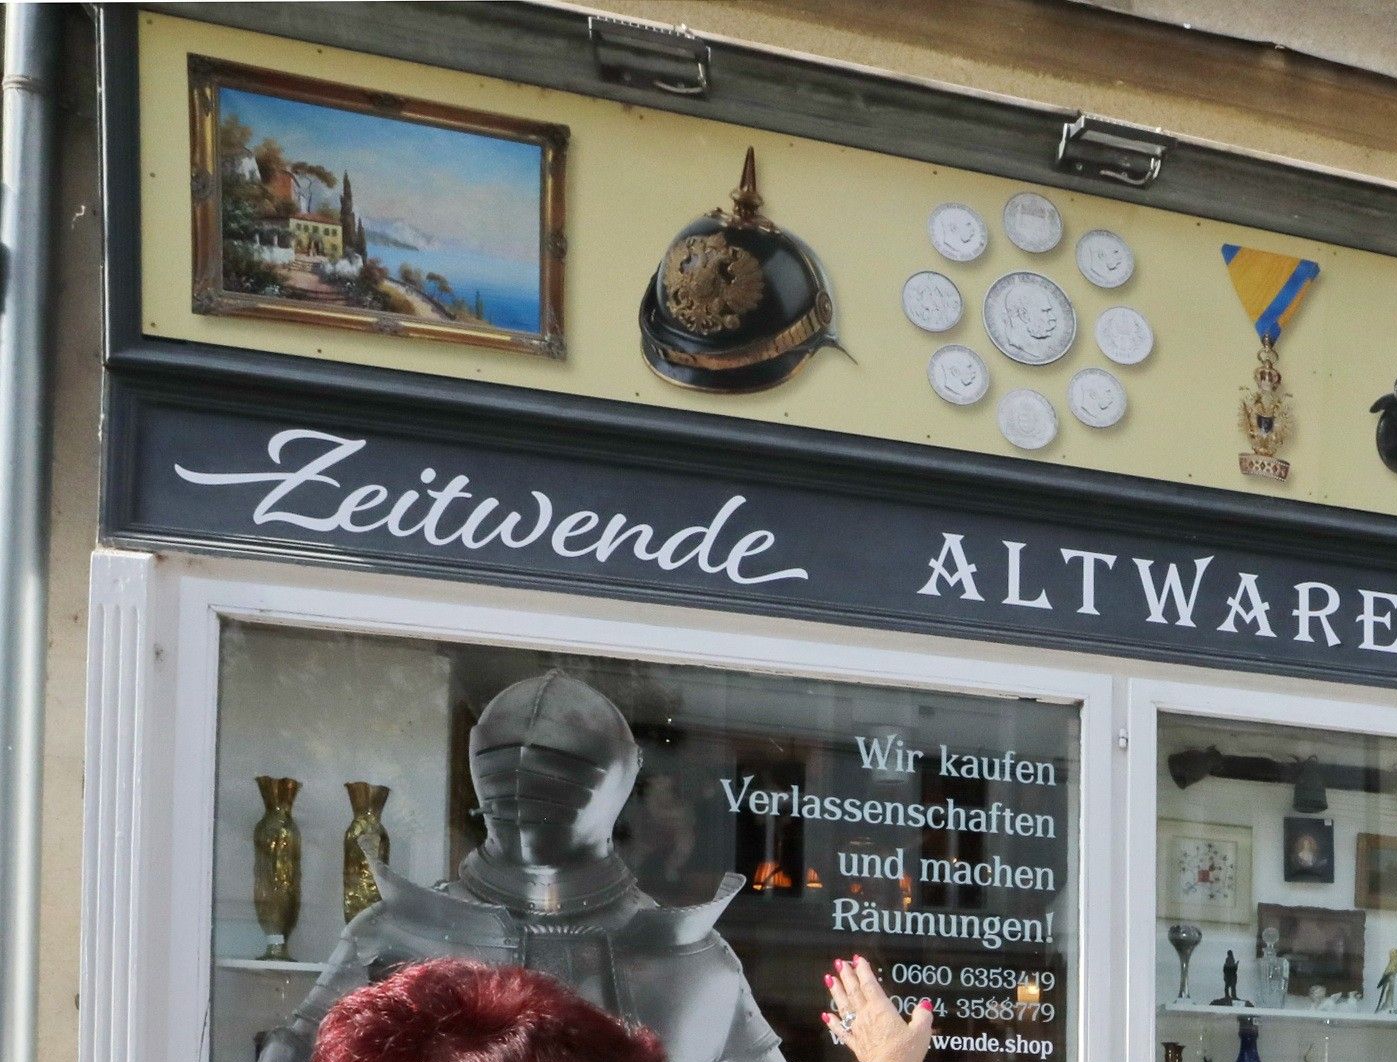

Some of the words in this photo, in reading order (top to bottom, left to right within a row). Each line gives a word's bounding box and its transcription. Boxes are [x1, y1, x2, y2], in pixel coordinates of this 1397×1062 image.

[174, 429, 808, 585] Zeitwende
[855, 734, 924, 774] Wir
[939, 745, 1056, 786] kaufen
[720, 775, 1056, 838] Verlassenschaften
[838, 849, 904, 880] und
[920, 856, 1055, 891] machen
[832, 898, 1055, 949] Räumungen!
[892, 963, 952, 986] 0660
[960, 967, 1055, 991] 6353419
[889, 995, 948, 1017] 064
[957, 997, 1055, 1023] 3588779
